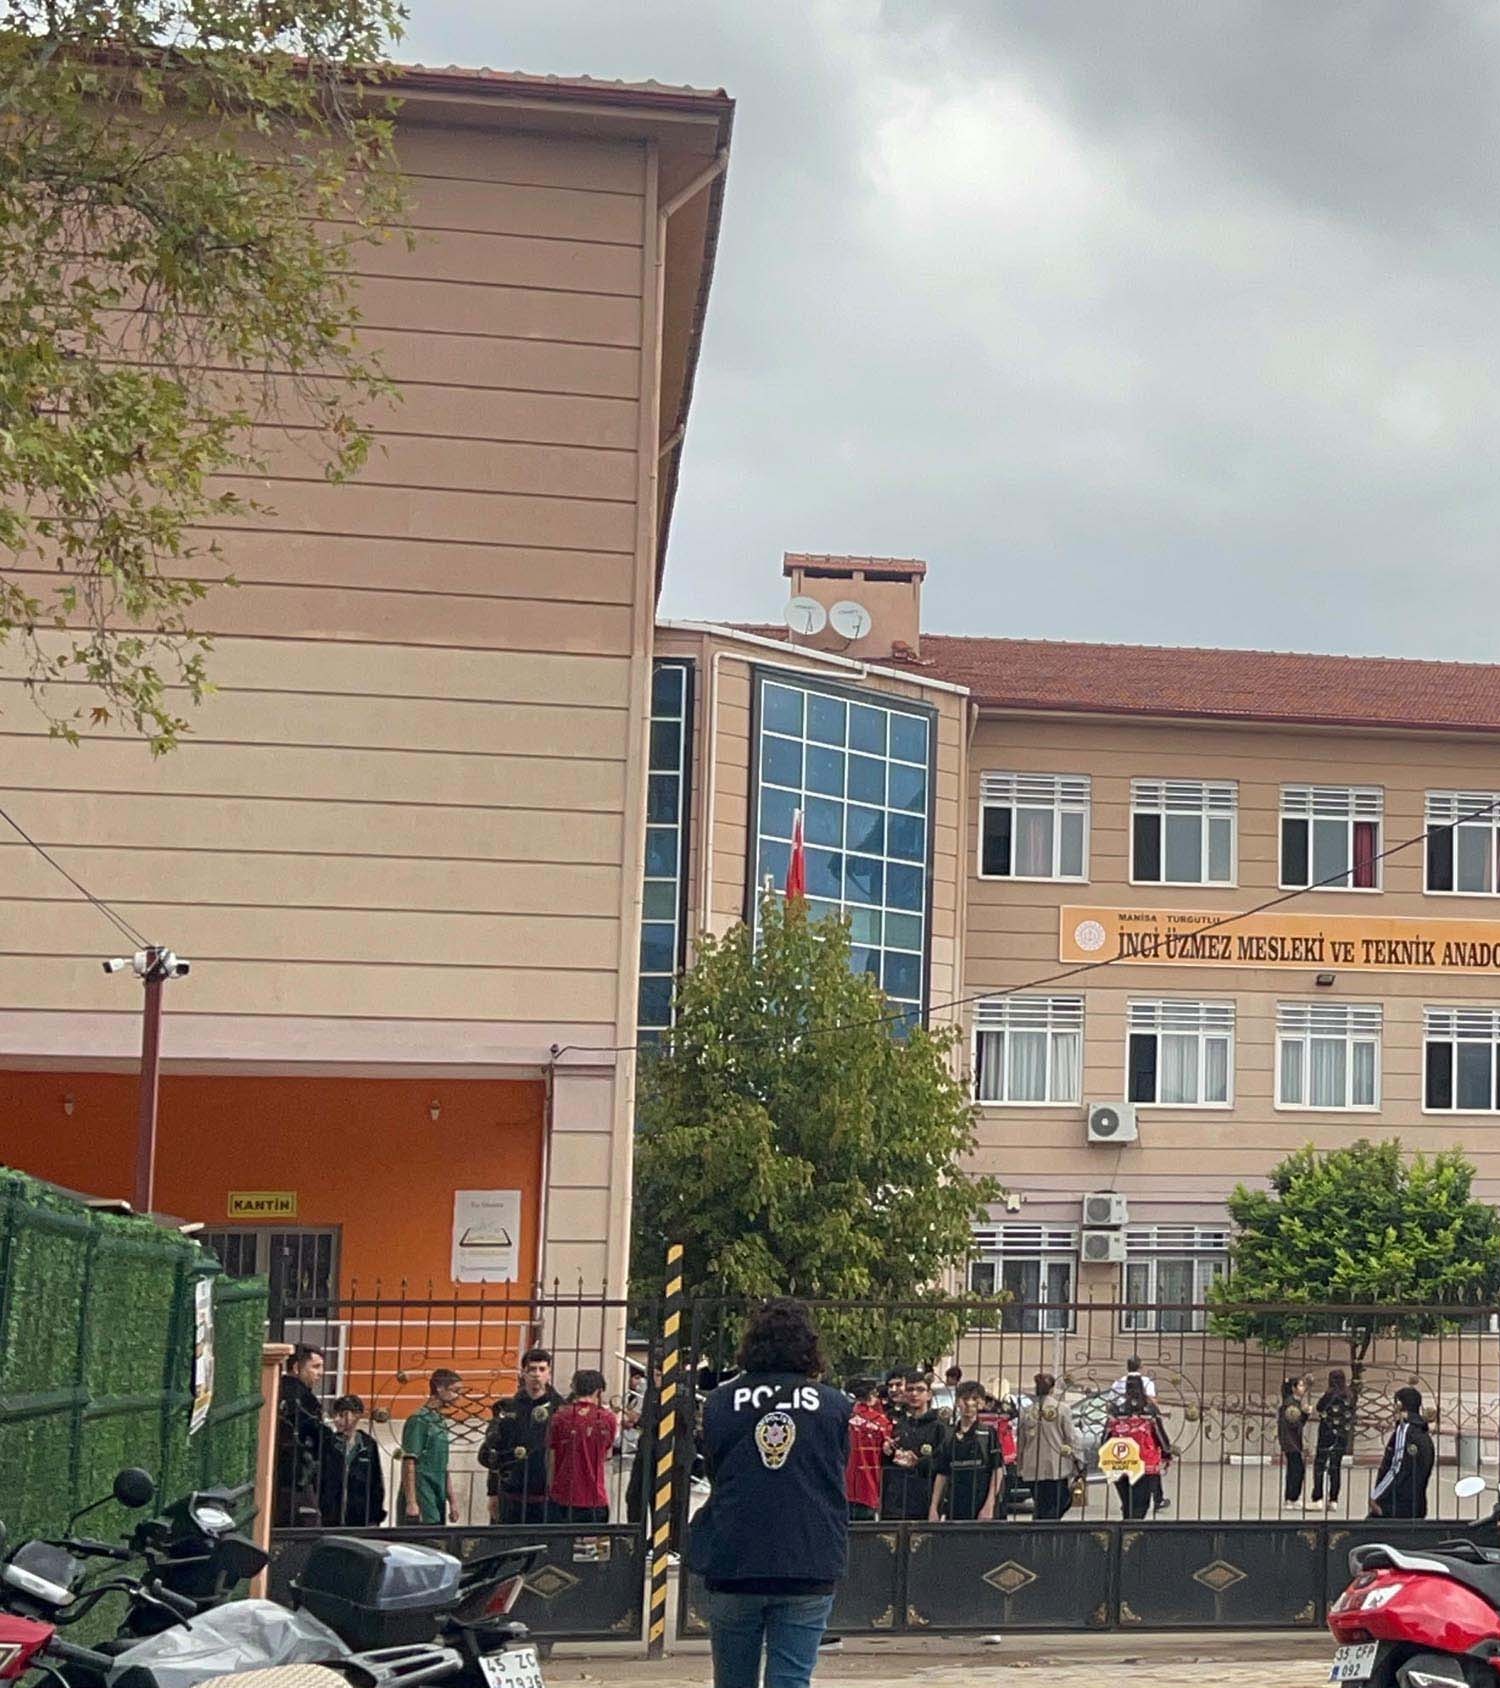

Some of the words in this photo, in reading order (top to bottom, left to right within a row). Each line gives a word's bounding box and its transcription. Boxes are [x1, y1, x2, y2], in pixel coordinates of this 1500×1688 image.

[1118, 912, 1157, 922] MANİSA
[1167, 915, 1221, 924] TURGUTLU
[1118, 925, 1160, 959] İNCİ
[1166, 927, 1232, 960] ÜZMEZ
[1237, 932, 1325, 962] MESLEKİ
[1330, 941, 1354, 963] VE
[1361, 934, 1435, 965] TEKNİK
[234, 1198, 290, 1210] KANTİN
[514, 1652, 536, 1669] ZC
